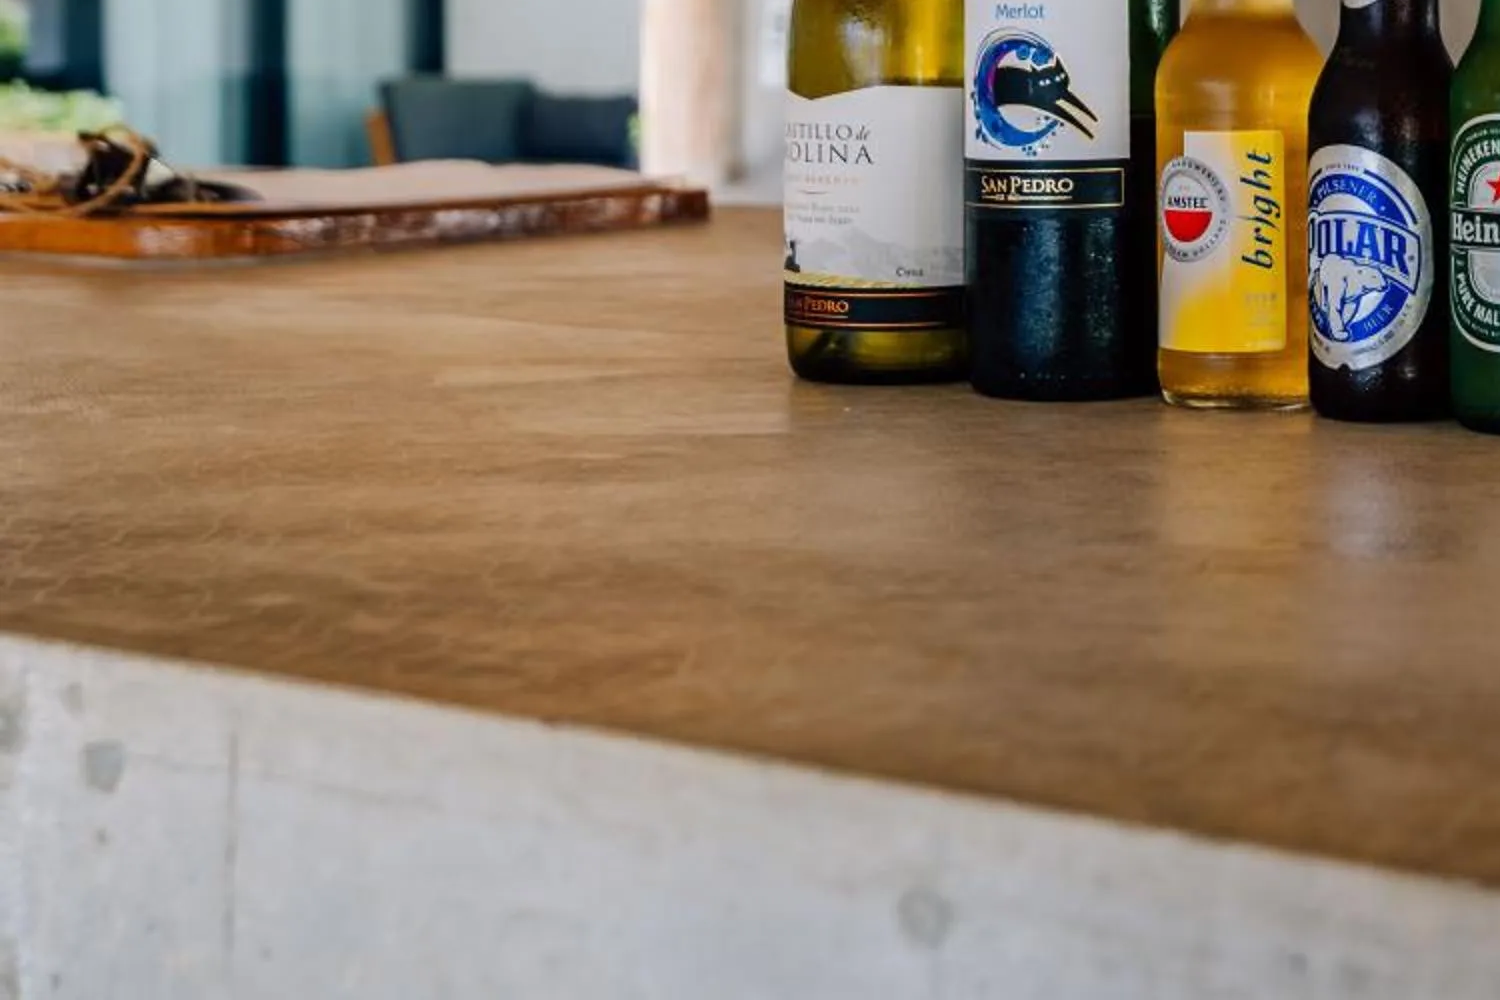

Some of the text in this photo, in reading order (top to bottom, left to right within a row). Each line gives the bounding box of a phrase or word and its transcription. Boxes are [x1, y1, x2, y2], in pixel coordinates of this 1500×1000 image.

[995, 3, 1045, 19] Merlot
[788, 141, 874, 165] OLINA
[1455, 139, 1500, 194] HEINEKEN
[981, 175, 1074, 193] SAN PEDRO
[1456, 273, 1476, 312] PURE
